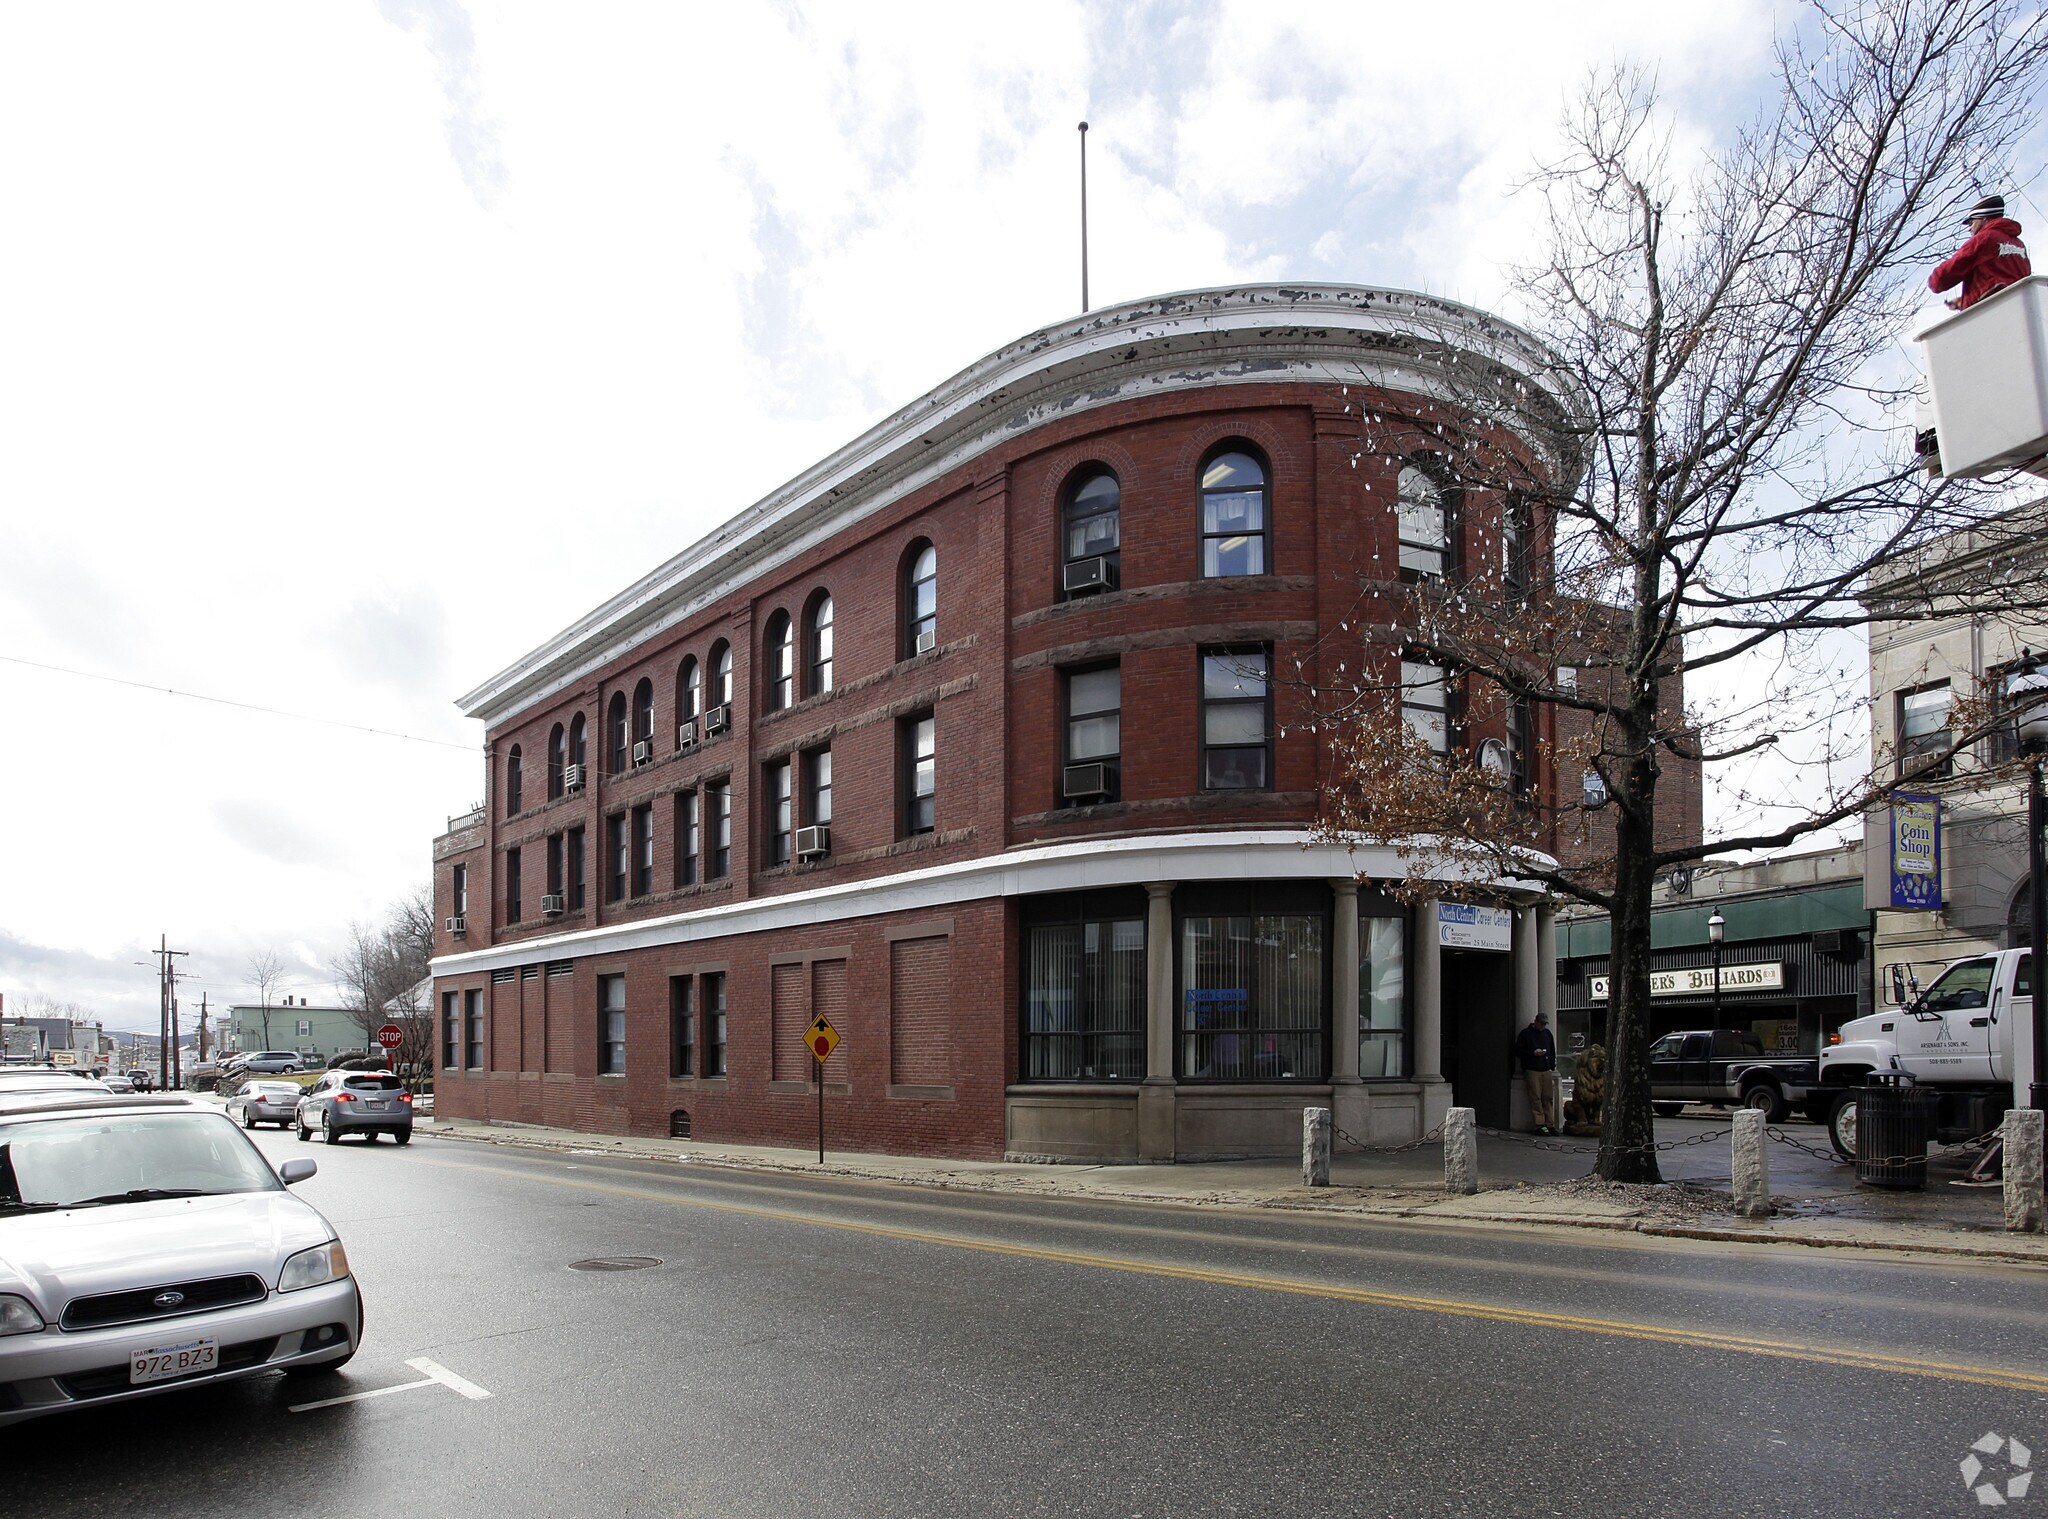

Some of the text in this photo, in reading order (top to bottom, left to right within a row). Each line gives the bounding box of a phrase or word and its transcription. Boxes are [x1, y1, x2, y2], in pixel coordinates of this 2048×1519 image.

[1901, 822, 1930, 839] Coin
[1900, 838, 1930, 857] Shop
[1440, 905, 1511, 927] North Central Career Centers
[380, 1032, 401, 1042] STOP
[134, 1343, 200, 1358] MAR Massachusetts
[135, 1347, 214, 1376] 972 BZ3
